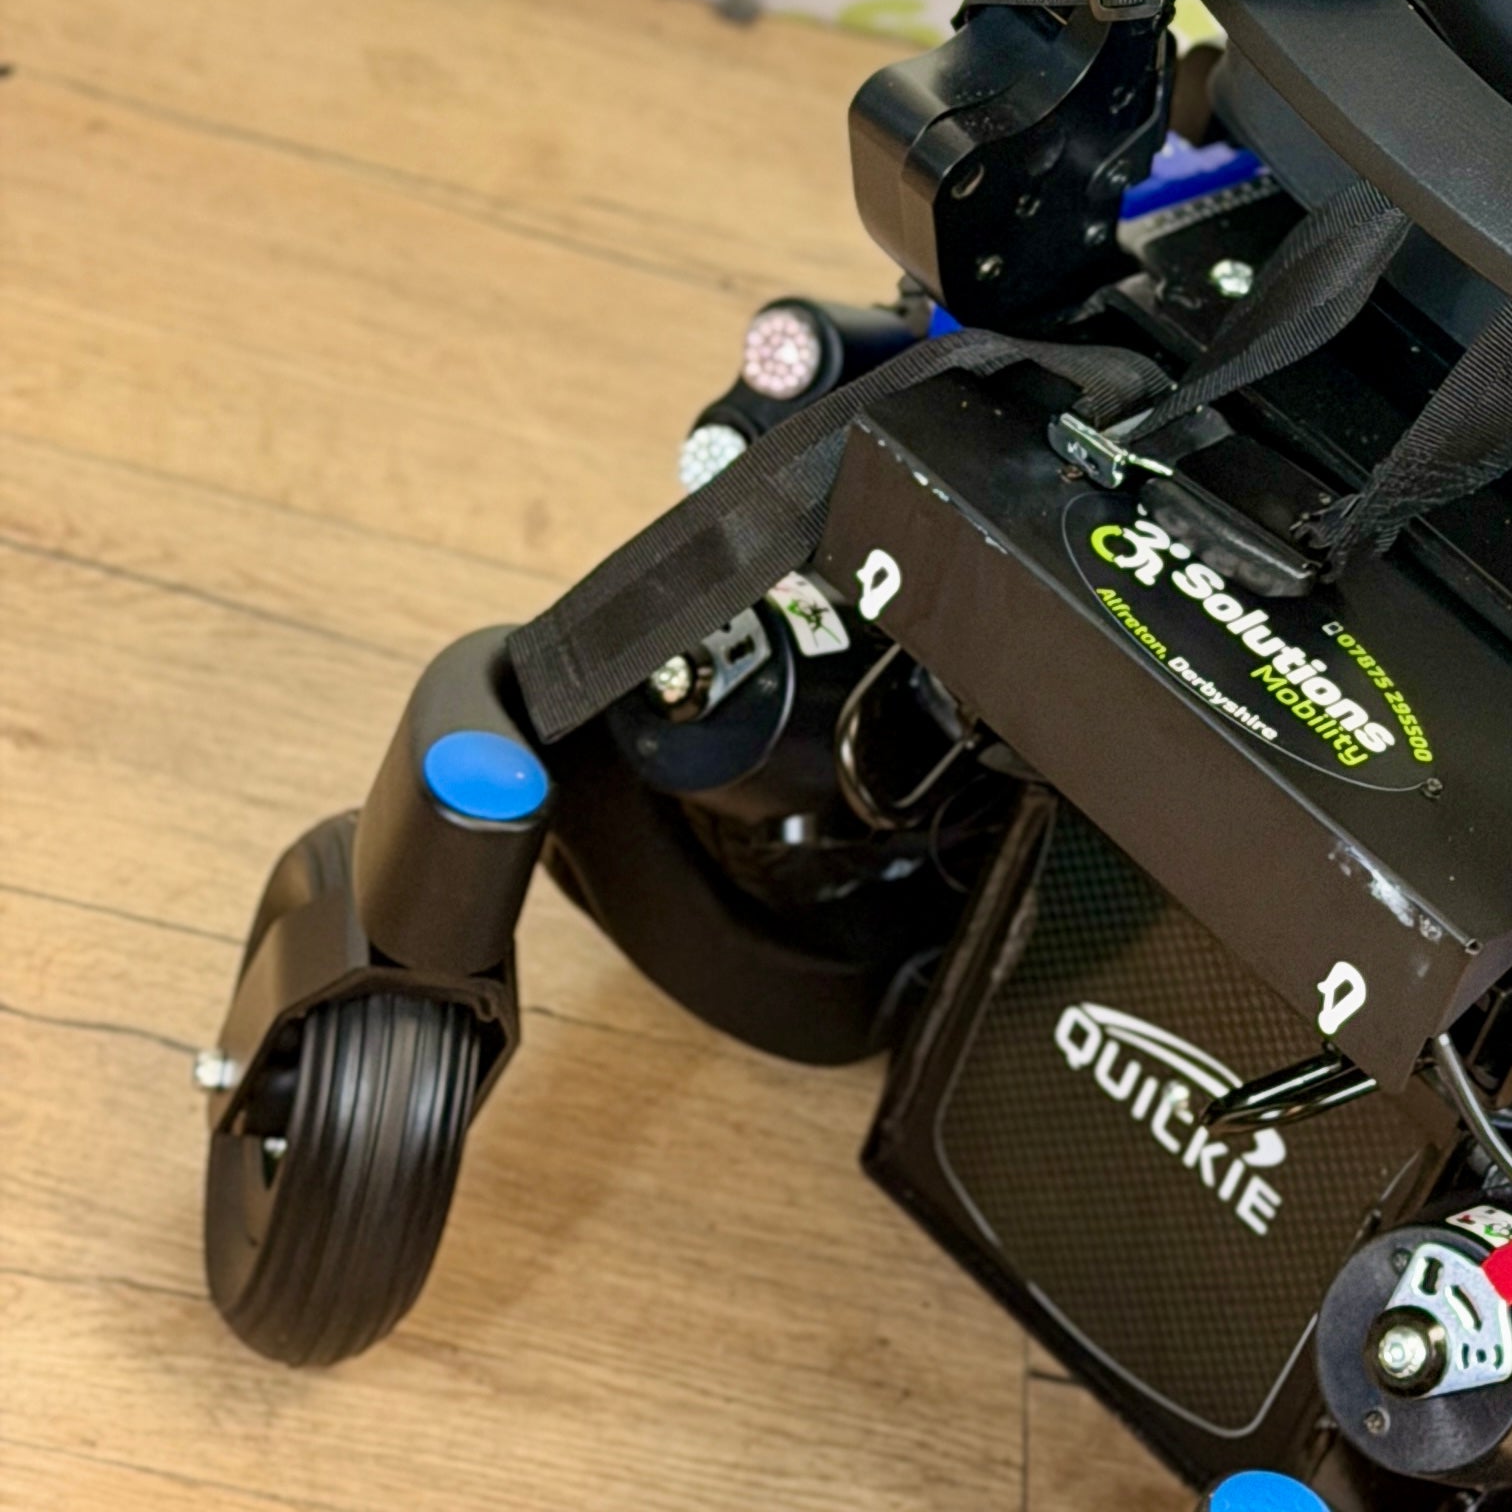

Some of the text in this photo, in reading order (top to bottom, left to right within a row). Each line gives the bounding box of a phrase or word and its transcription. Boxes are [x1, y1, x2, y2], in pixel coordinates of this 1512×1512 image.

[1167, 656, 1278, 741] Derbyshire
[1171, 562, 1396, 754] Solutions
[1250, 664, 1369, 767] Mobility
[1336, 633, 1433, 763] 07875 295500
[1054, 1004, 1285, 1237] QUICKIE
